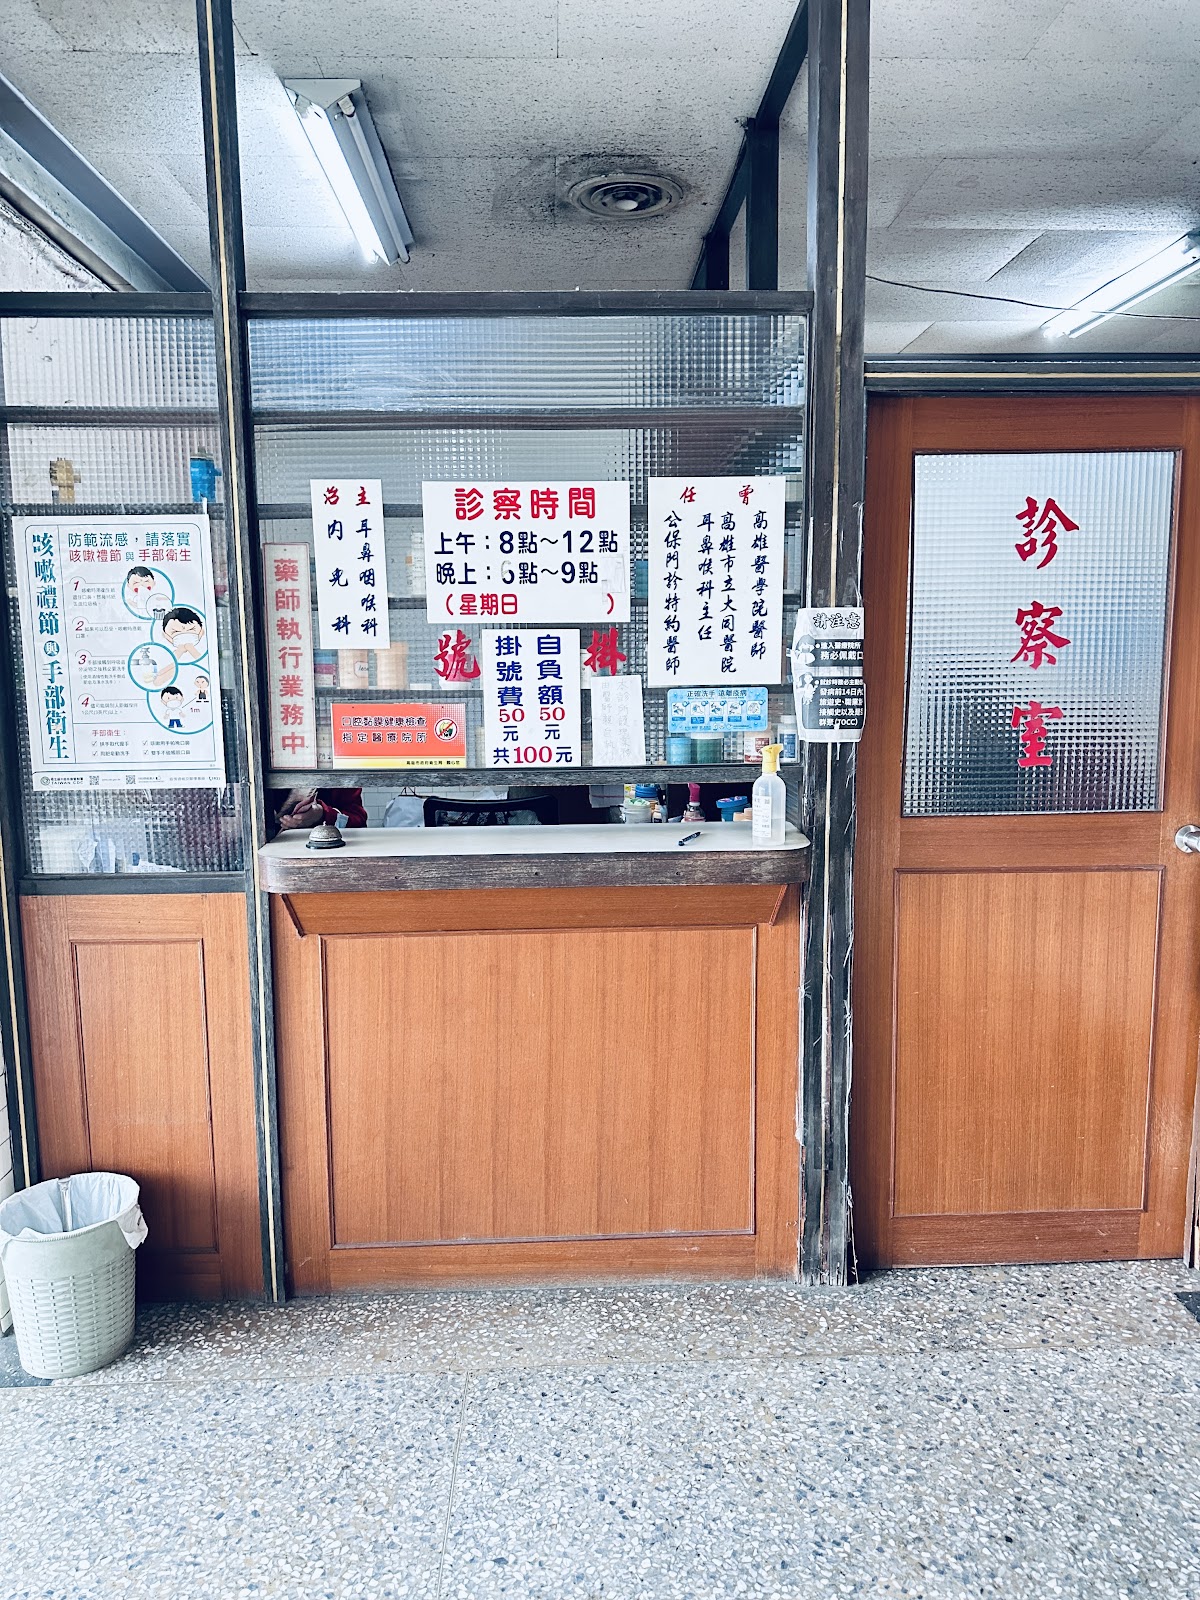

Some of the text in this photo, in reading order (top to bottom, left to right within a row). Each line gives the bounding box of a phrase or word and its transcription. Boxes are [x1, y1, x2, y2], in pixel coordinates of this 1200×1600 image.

[454, 487, 596, 521] 診察時間
[67, 532, 191, 548] 防範流感，請落實
[356, 518, 379, 638] 耳鼻咽喉科
[75, 620, 85, 632] 2
[812, 611, 862, 630] 請注意
[1010, 496, 1080, 768] 診察室
[78, 654, 87, 665] 3
[274, 558, 306, 755] 藥師執行業務中
[81, 696, 90, 708] 4
[341, 732, 428, 744] 指定醫療院所
[493, 746, 573, 765] 共100元
